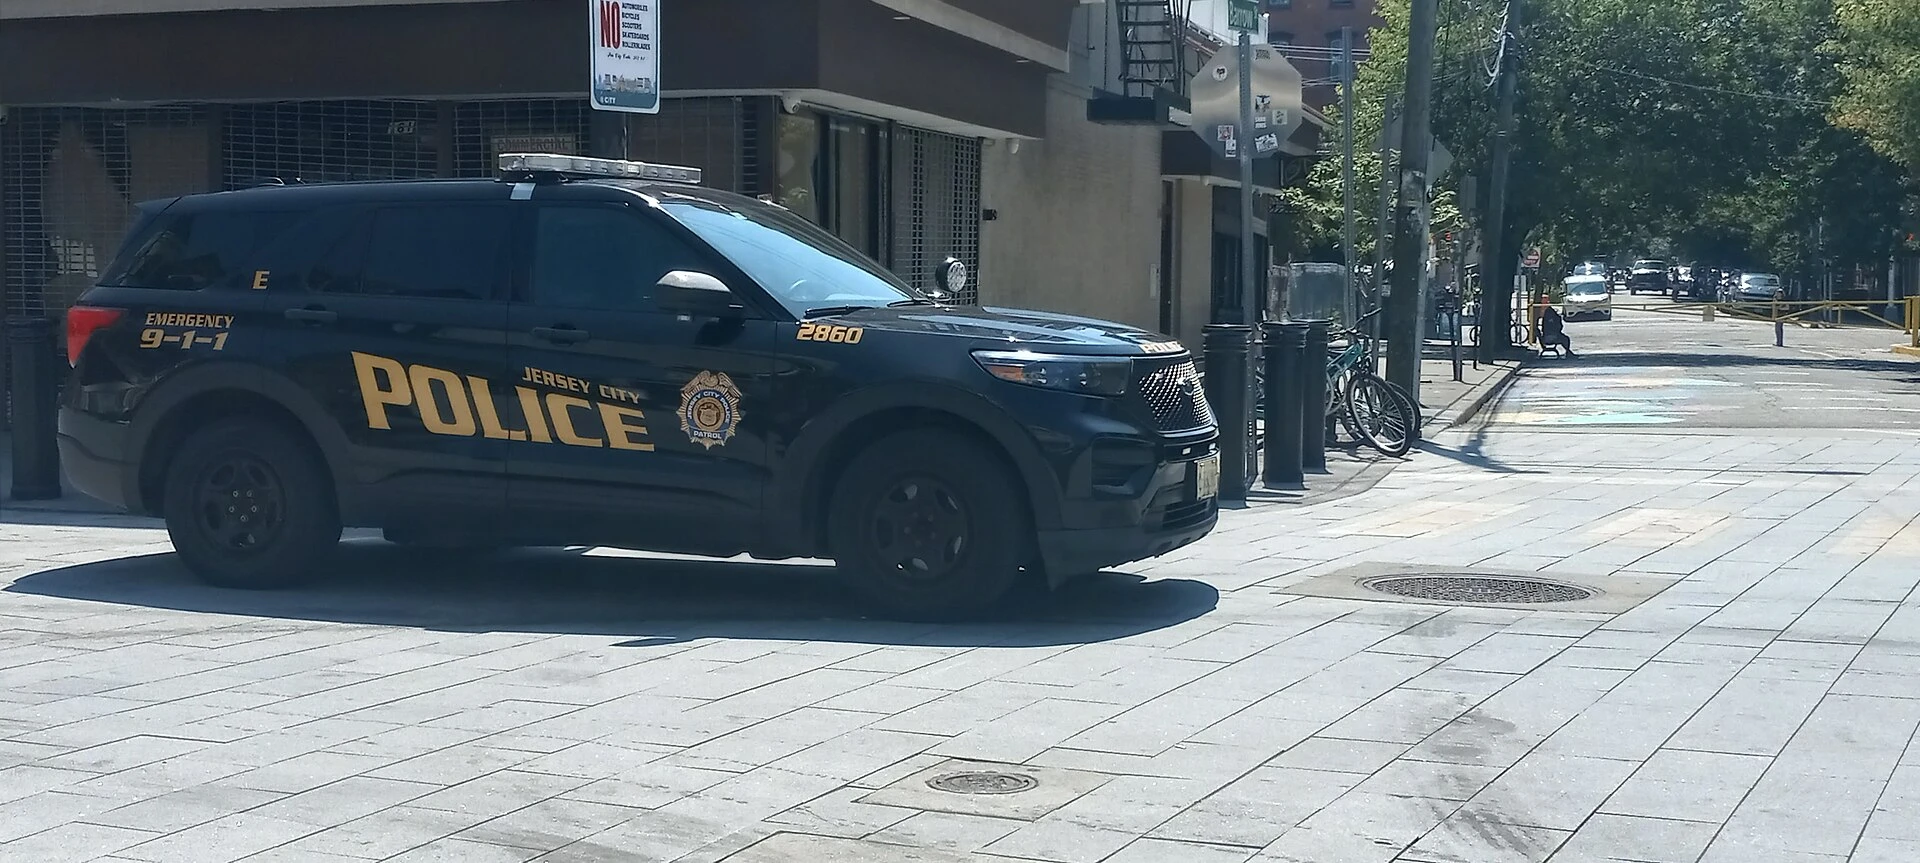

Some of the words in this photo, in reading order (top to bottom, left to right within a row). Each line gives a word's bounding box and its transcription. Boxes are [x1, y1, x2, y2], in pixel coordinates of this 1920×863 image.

[601, 1, 620, 49] NO
[622, 21, 642, 30] SCOOTERS
[498, 137, 569, 151] COMMERCIAL
[252, 270, 270, 290] E
[145, 312, 235, 329] EMERGENCY
[139, 328, 229, 351] 9-1-1
[796, 323, 864, 344] 2860
[1139, 340, 1185, 354] POLIC
[522, 366, 590, 394] JERSEY
[598, 384, 641, 405] CITY
[351, 350, 655, 452] POLICE
[687, 394, 701, 420] JERSEY
[703, 390, 720, 399] CITY
[720, 397, 731, 423] POLICE
[693, 430, 723, 440] PATROL
